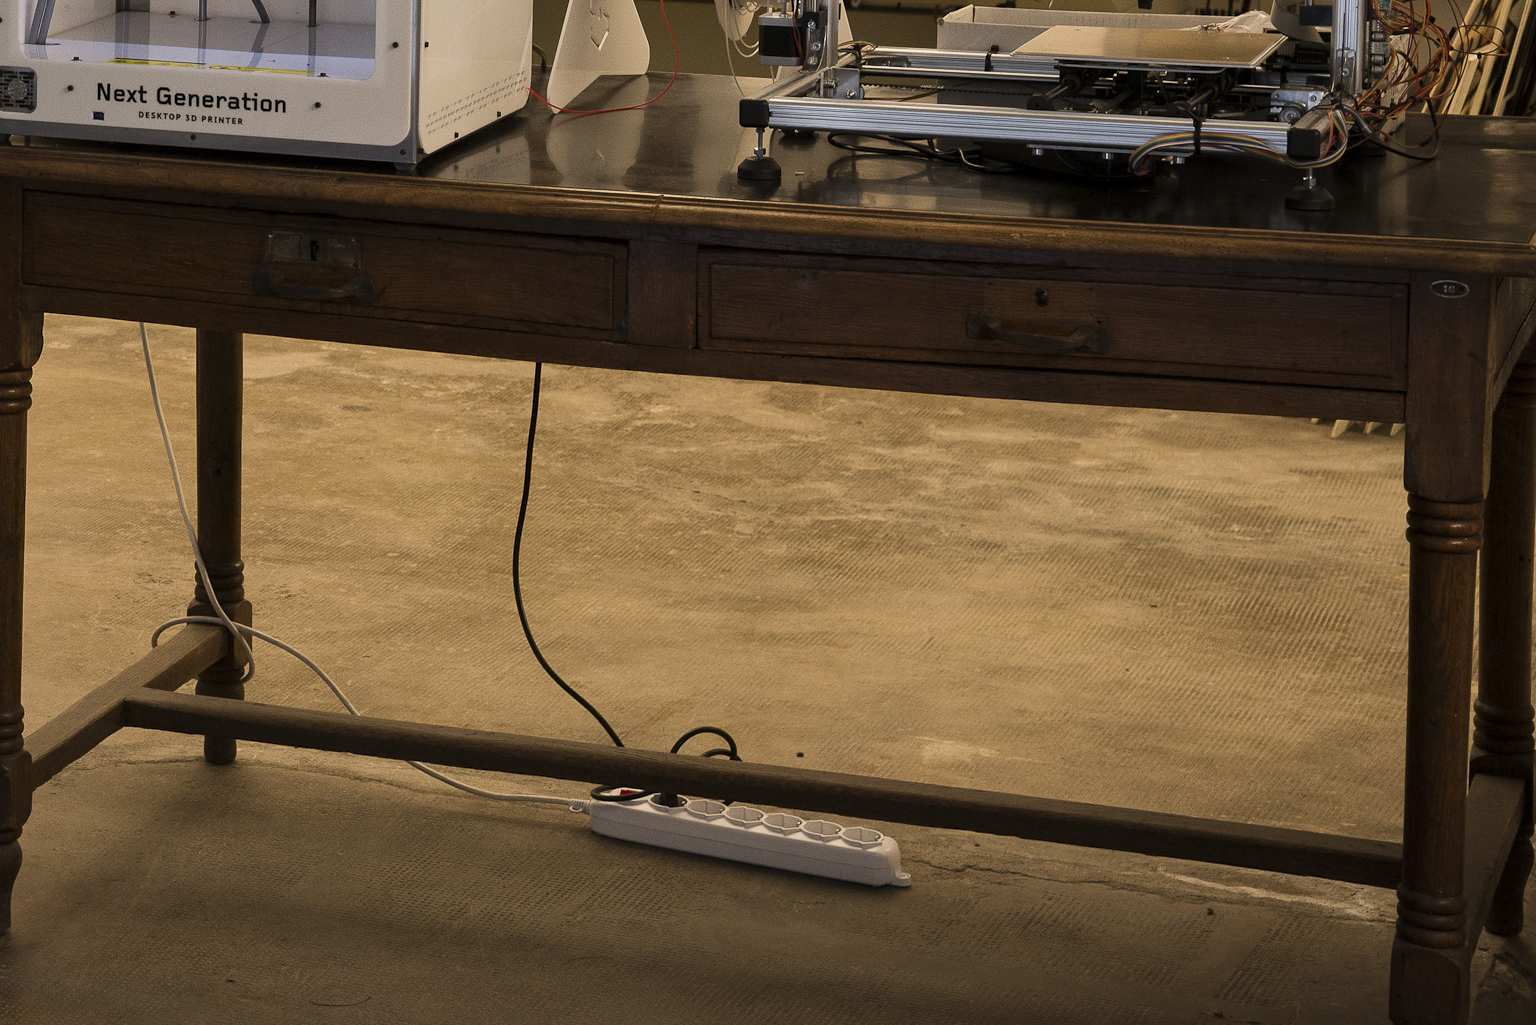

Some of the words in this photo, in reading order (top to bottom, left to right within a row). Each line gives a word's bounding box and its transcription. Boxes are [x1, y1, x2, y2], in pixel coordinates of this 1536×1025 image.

[97, 82, 147, 104] Next
[156, 86, 287, 113] Generation
[138, 111, 182, 121] DESKTOP
[185, 114, 197, 123] 3D
[201, 116, 244, 126] PRINTER
